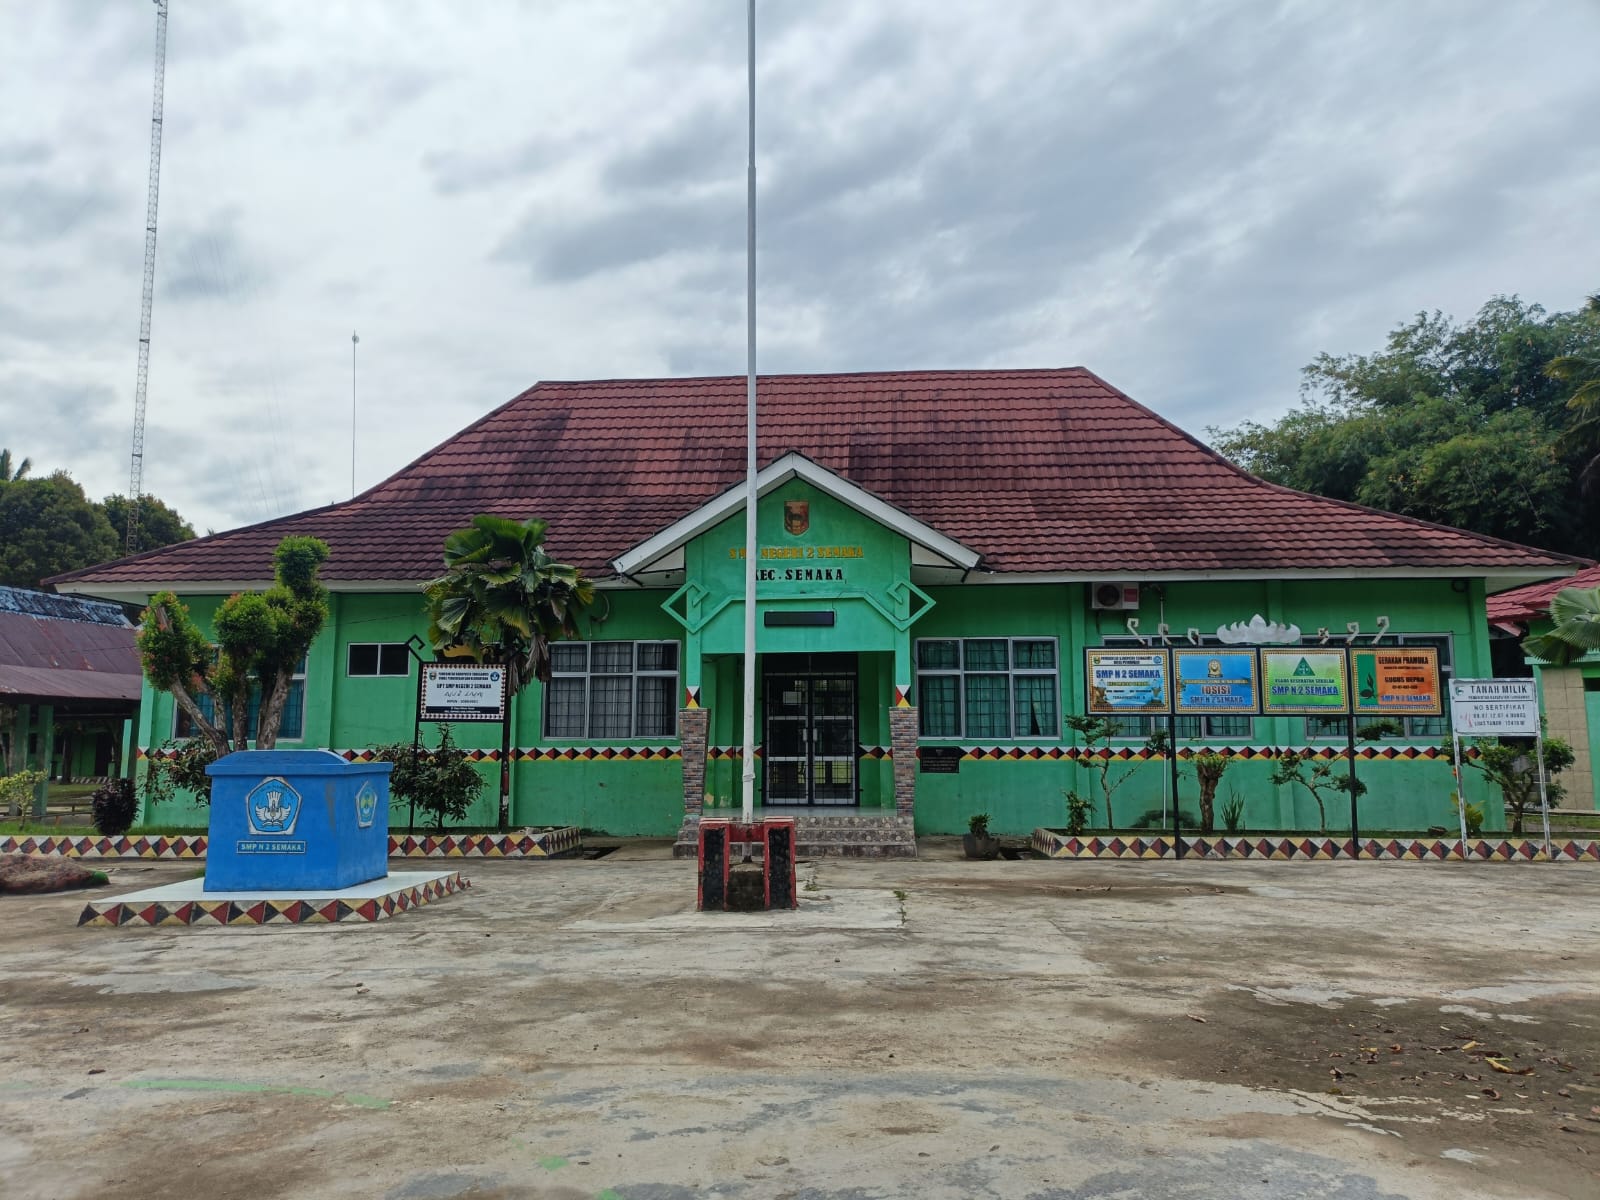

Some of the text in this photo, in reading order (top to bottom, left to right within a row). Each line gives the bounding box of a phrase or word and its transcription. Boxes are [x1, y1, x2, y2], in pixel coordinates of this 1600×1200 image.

[761, 547, 804, 559] NEGERI
[807, 547, 815, 559] 2
[817, 546, 864, 559] SEMAKA
[785, 568, 843, 581] SEMAKA
[1095, 669, 1161, 679] SMP N 2 SEMAKA
[1271, 685, 1290, 696] SMP
[1297, 686, 1304, 696] 2
[1305, 685, 1339, 696] SEMAKA
[1471, 685, 1527, 694] TANAH MILIK
[241, 843, 302, 851] SMP N 2 SEMAKA
